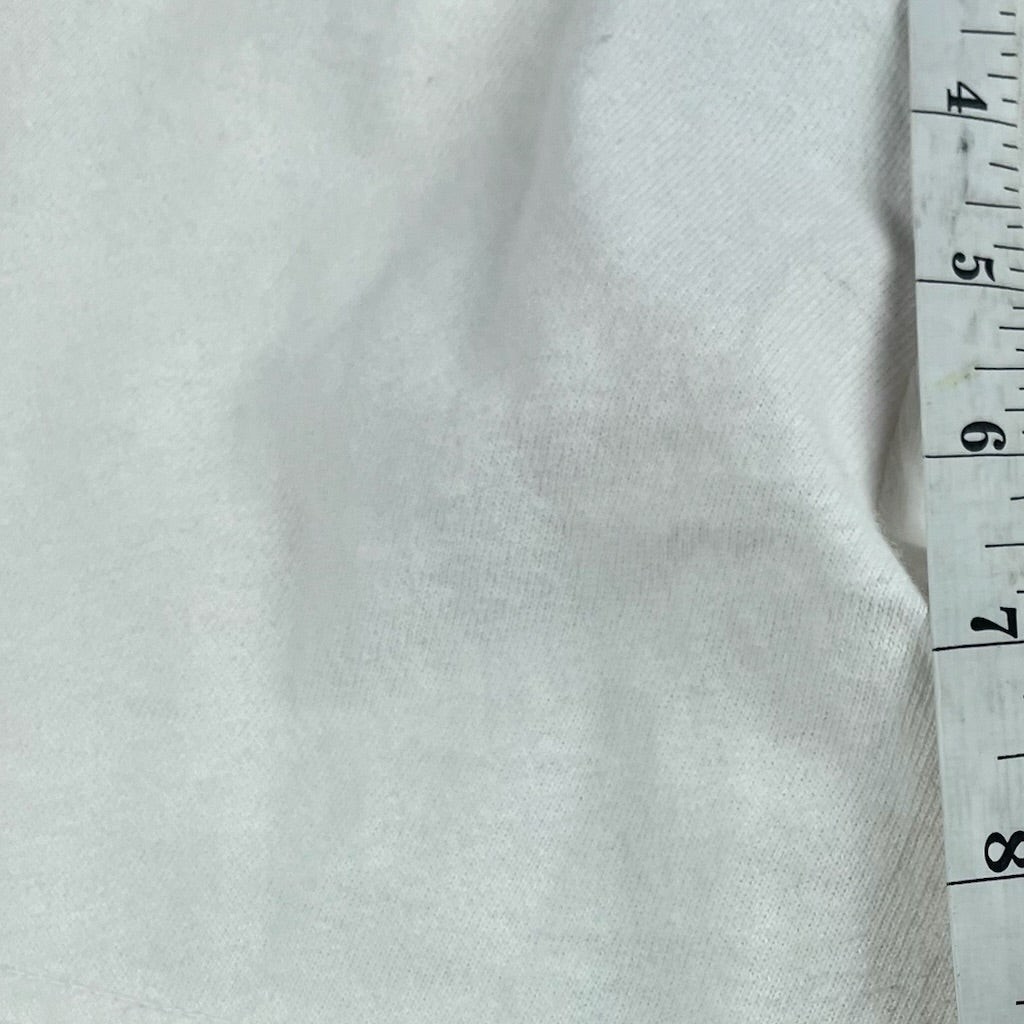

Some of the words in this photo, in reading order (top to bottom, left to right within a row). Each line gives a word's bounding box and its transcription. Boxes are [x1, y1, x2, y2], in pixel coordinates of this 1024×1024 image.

[946, 81, 988, 114] 4
[951, 251, 996, 282] 5
[960, 420, 1007, 453] 6
[970, 606, 1019, 639] 7
